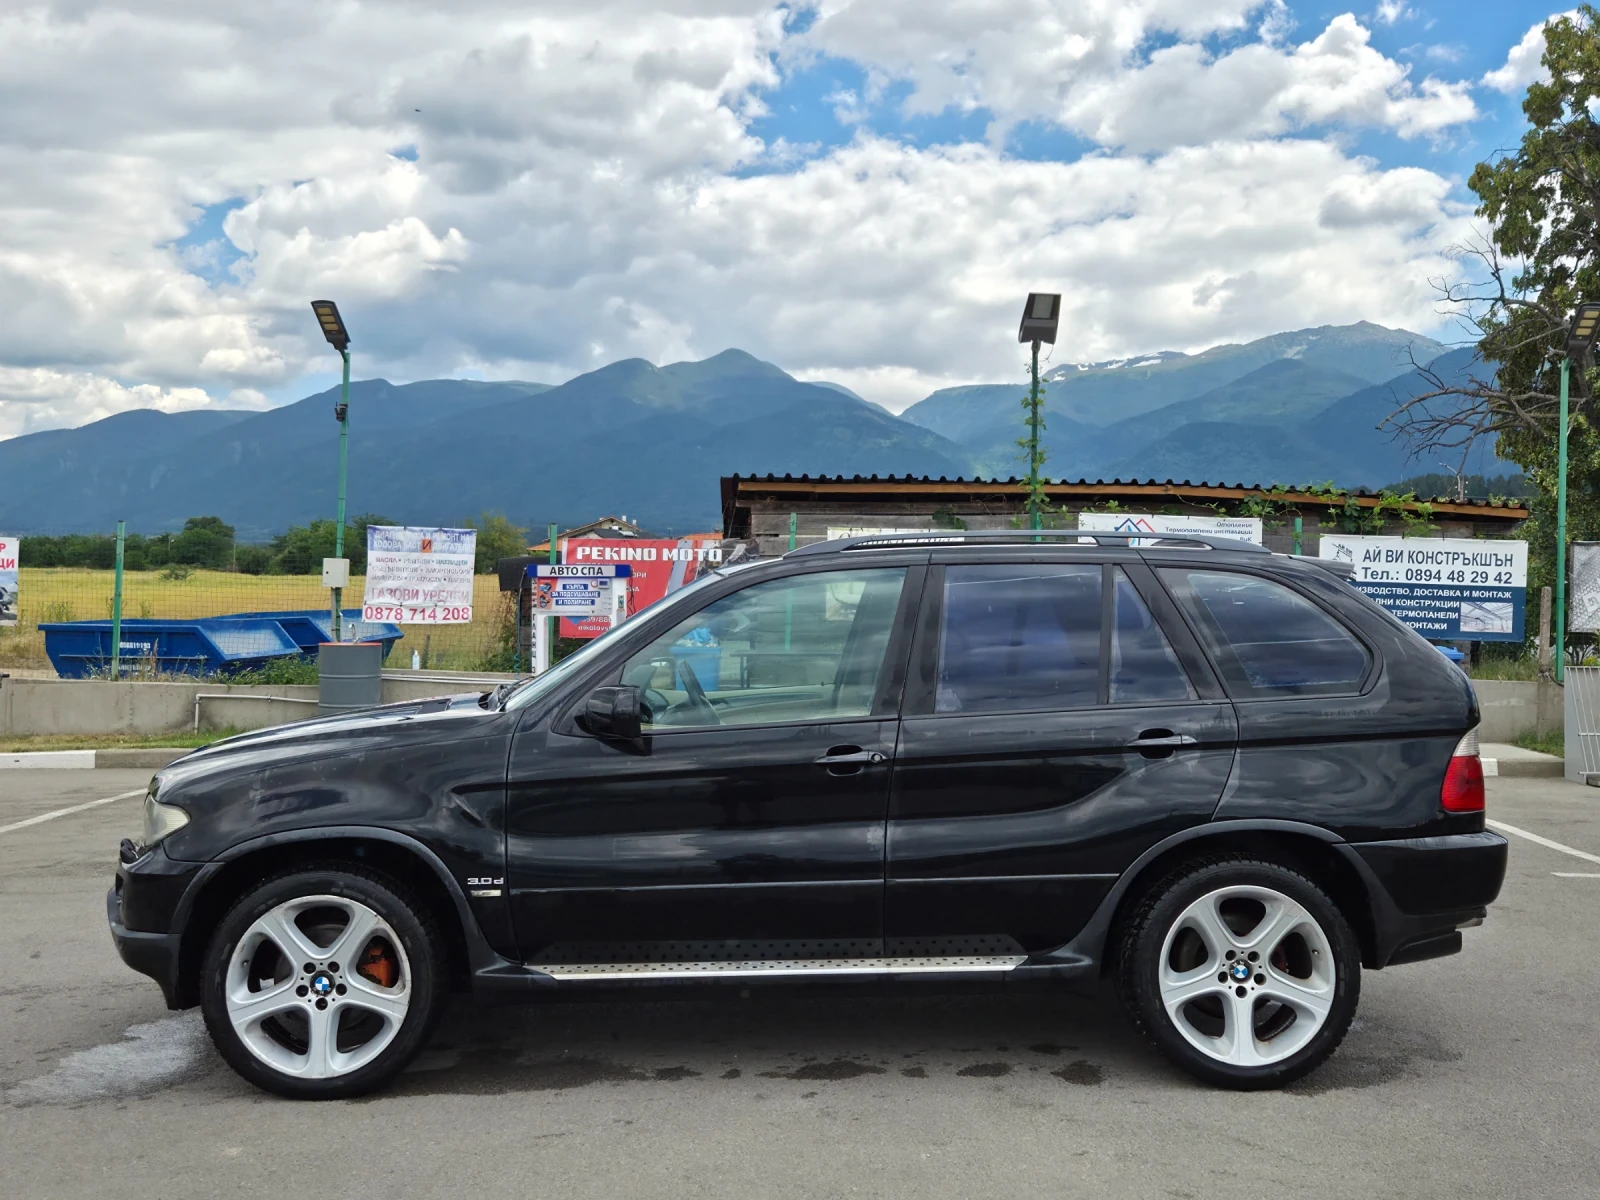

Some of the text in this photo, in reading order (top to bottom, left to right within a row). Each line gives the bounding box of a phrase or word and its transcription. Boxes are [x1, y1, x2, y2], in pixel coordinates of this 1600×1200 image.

[577, 546, 722, 562] PEKINO MOTO
[1363, 546, 1381, 563] АЙ
[1385, 549, 1404, 563] ВИ
[1408, 550, 1513, 567] КОНСТРЪКШЪН
[550, 567, 603, 575] АВТО СПА
[1362, 567, 1512, 584] Тел.: 0894 48 29 42
[372, 587, 419, 601] ГАЗОВИ
[1414, 589, 1461, 597] ДОСТАВКА
[1396, 599, 1459, 608] КОНСТРУКЦИИ
[364, 606, 470, 620] 0878 714 208
[1392, 610, 1458, 618] ТЕРМОПАНЕЛИ
